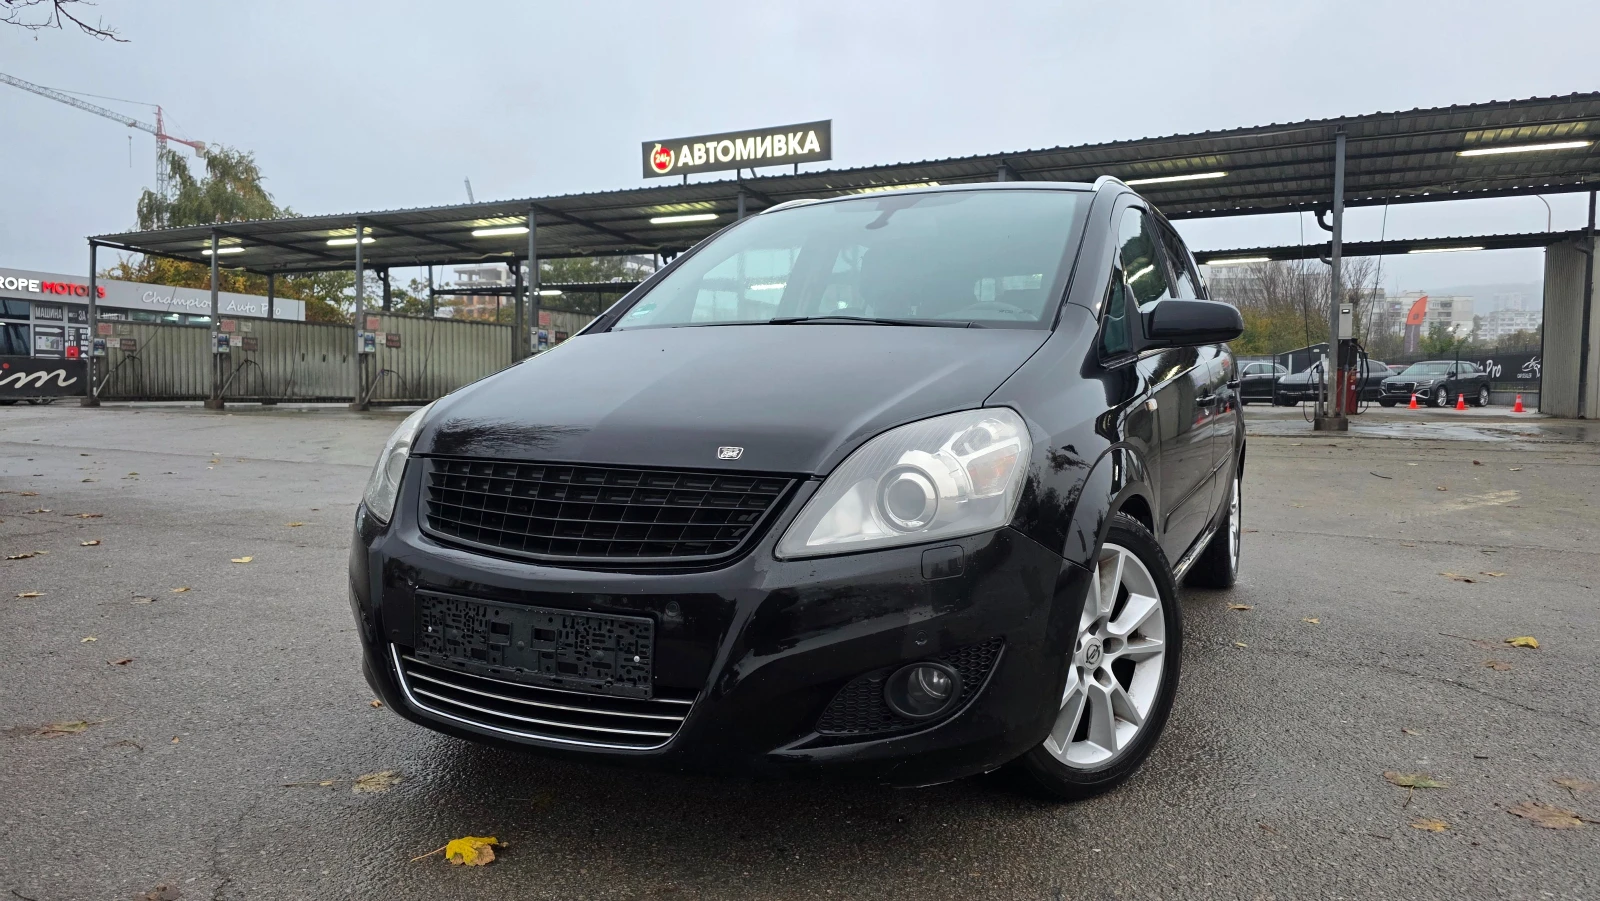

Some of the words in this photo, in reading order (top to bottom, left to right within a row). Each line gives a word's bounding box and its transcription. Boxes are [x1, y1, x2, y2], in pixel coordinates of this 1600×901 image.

[677, 130, 821, 167] АВТОМИВКА
[42, 280, 106, 299] MOTOS
[35, 306, 63, 320] МАШИНА
[226, 299, 256, 313] Auto
[260, 303, 281, 316] Po
[1486, 359, 1502, 379] Pro
